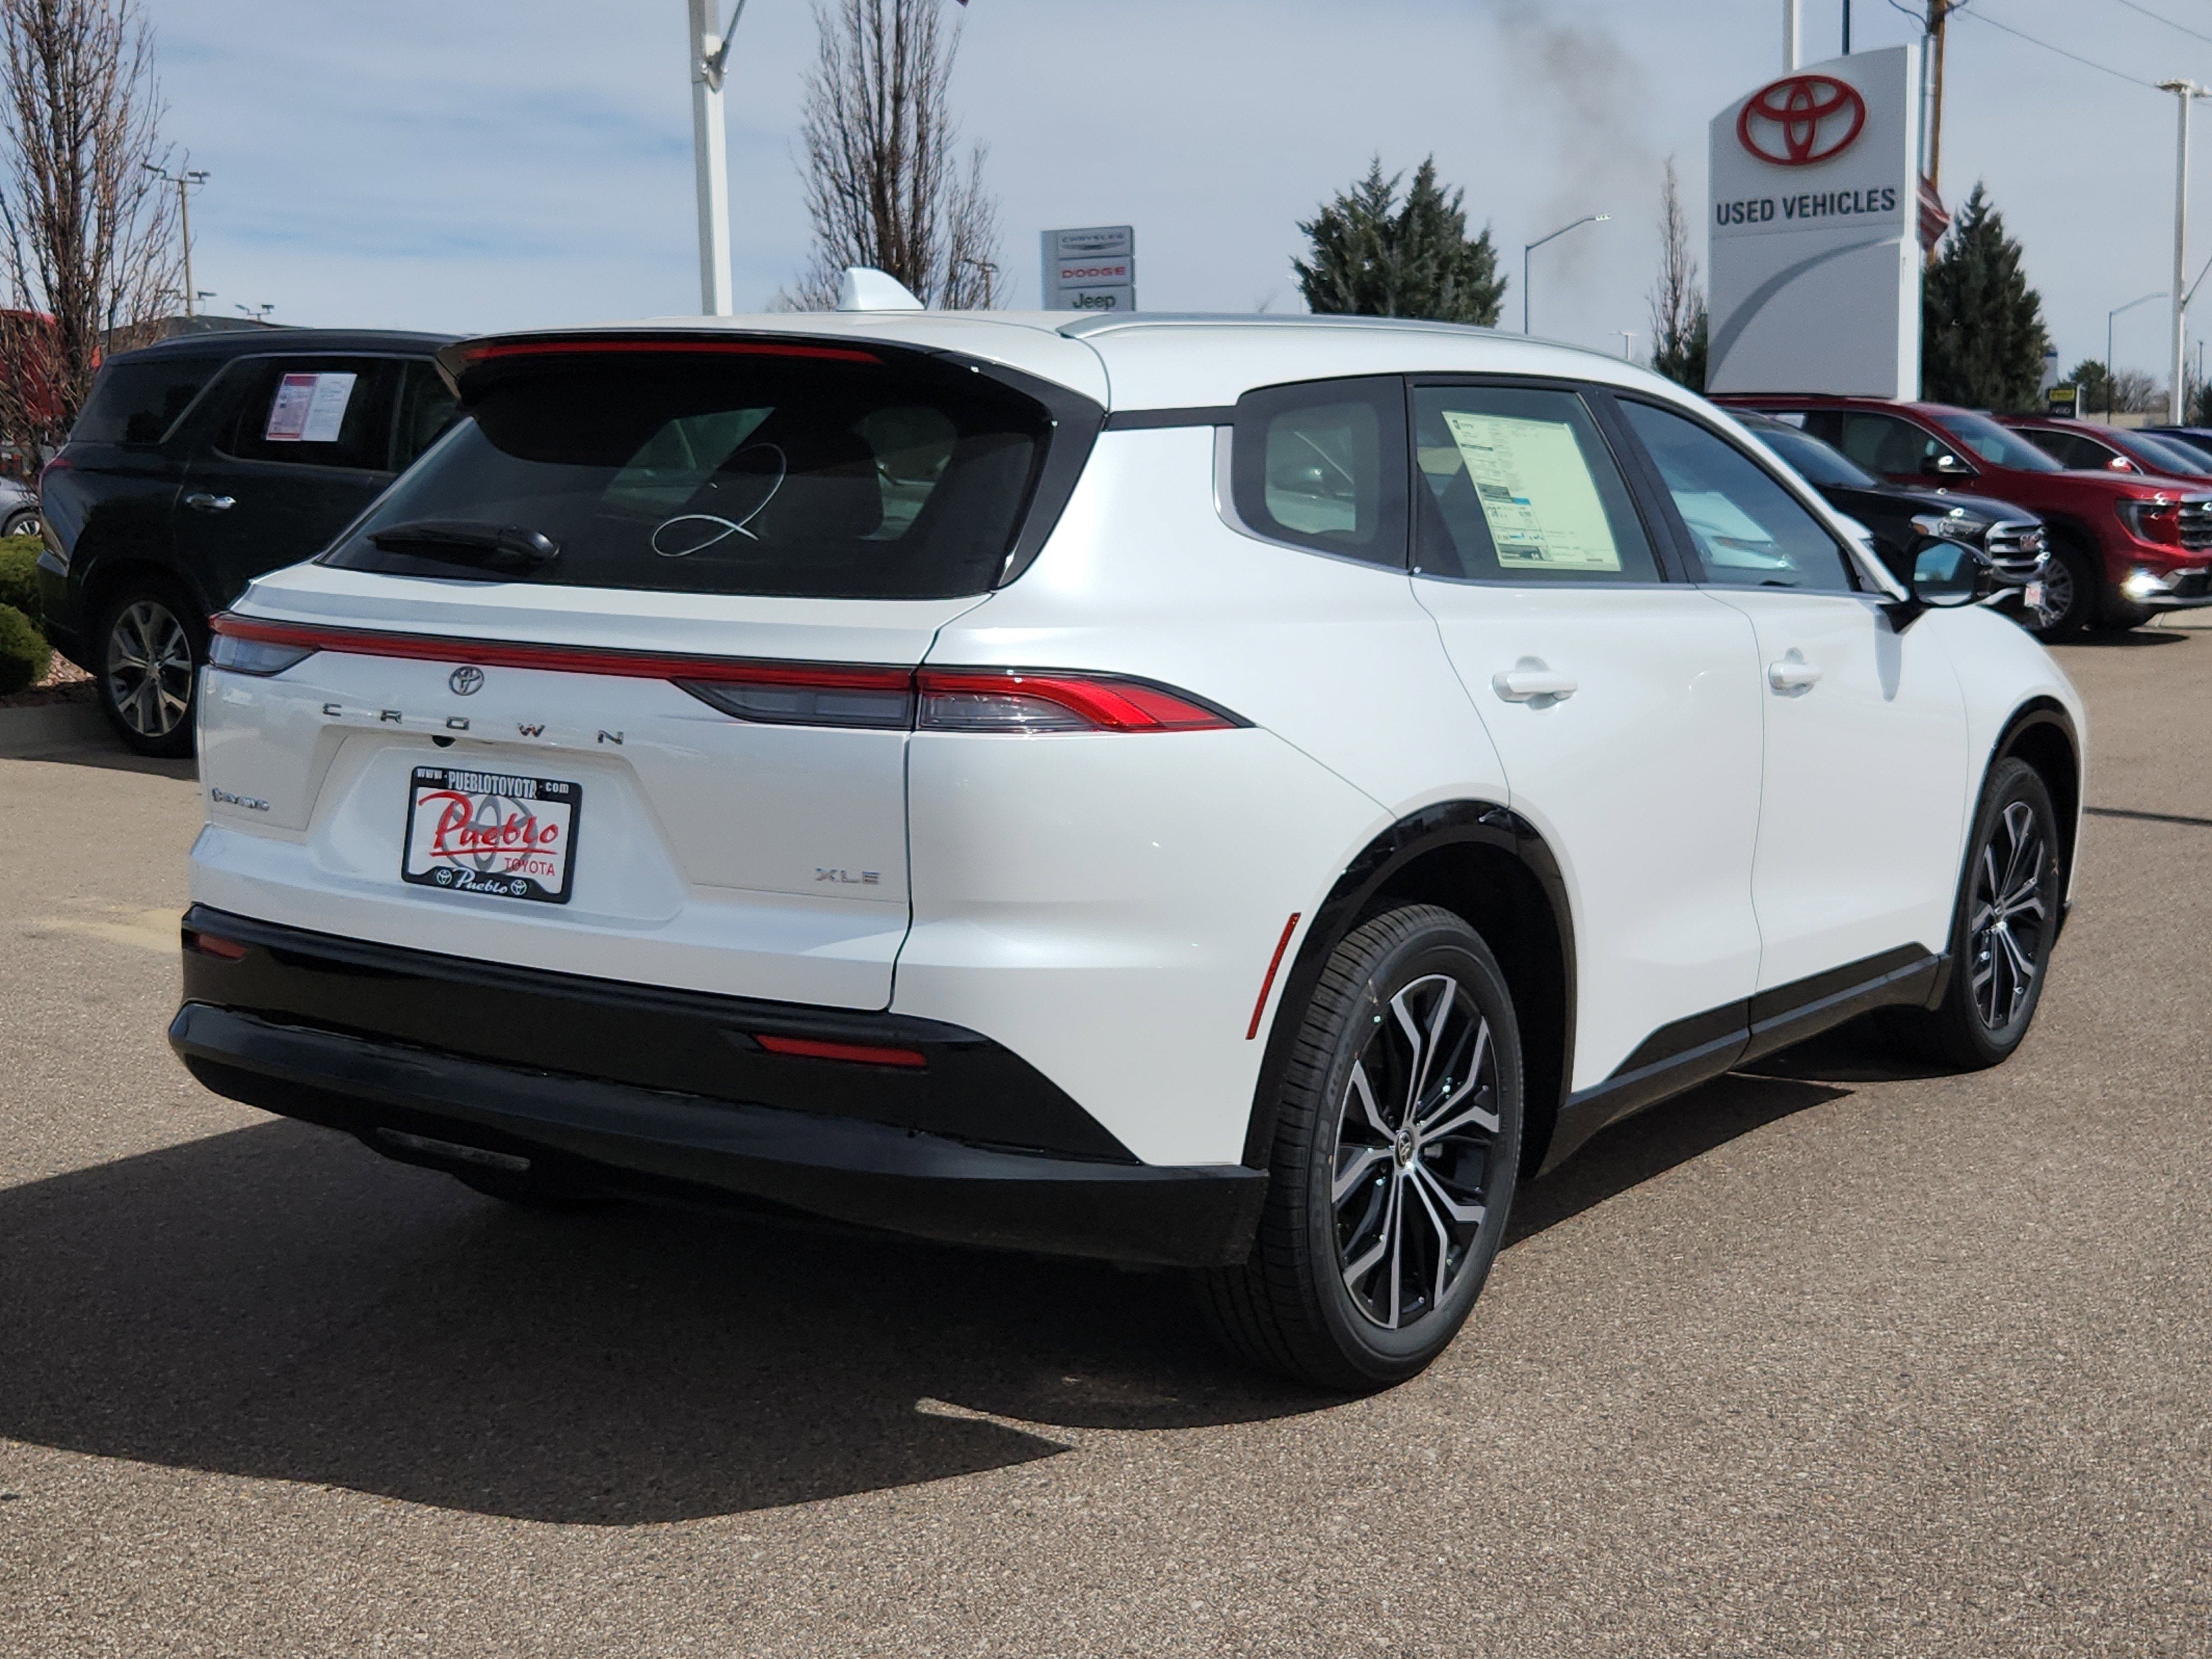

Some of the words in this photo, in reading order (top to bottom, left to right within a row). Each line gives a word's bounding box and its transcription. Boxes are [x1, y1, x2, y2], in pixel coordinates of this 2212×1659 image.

[1716, 199, 1774, 226] USED
[1782, 188, 1896, 219] VEHICLES
[1062, 267, 1126, 279] DODGE
[1072, 293, 1117, 311] Jeep
[322, 703, 625, 745] CROWN
[418, 790, 559, 849] Pueblo
[504, 857, 556, 877] TOYOTA
[815, 867, 881, 885] XLE
[452, 867, 508, 894] Pueblo
